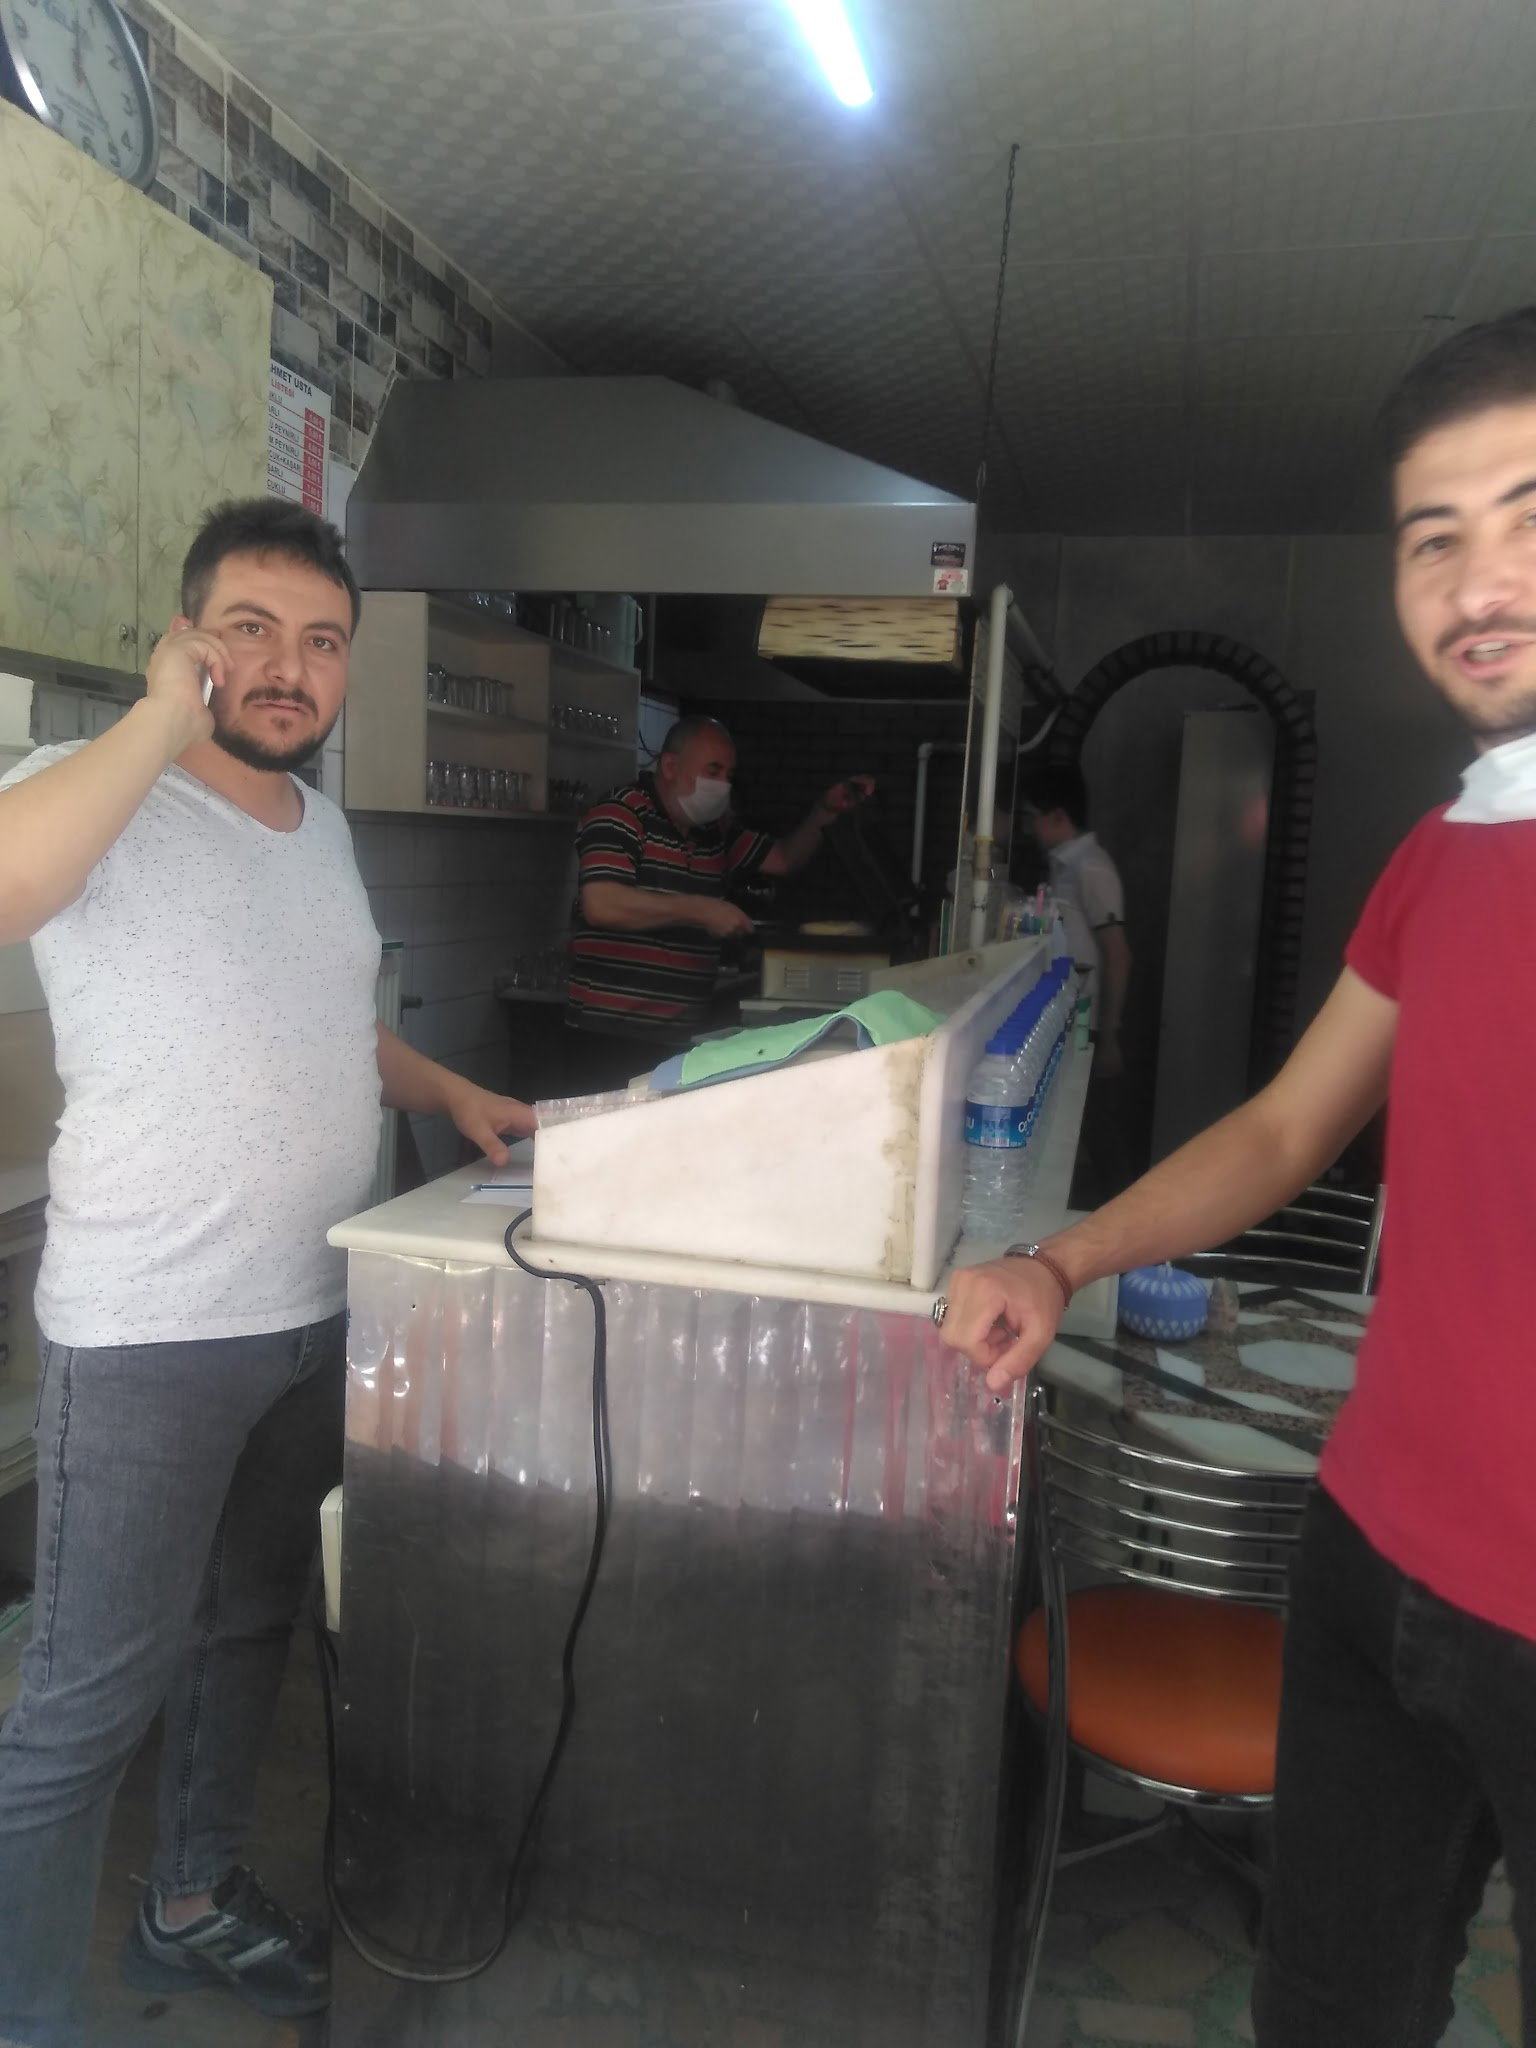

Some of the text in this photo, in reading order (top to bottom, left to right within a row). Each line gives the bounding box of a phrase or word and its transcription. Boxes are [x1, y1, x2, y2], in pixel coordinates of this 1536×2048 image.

[106, 44, 120, 71] 2
[121, 92, 136, 117] 3
[121, 130, 133, 151] 4
[108, 142, 120, 167] 5
[294, 378, 312, 397] USTA
